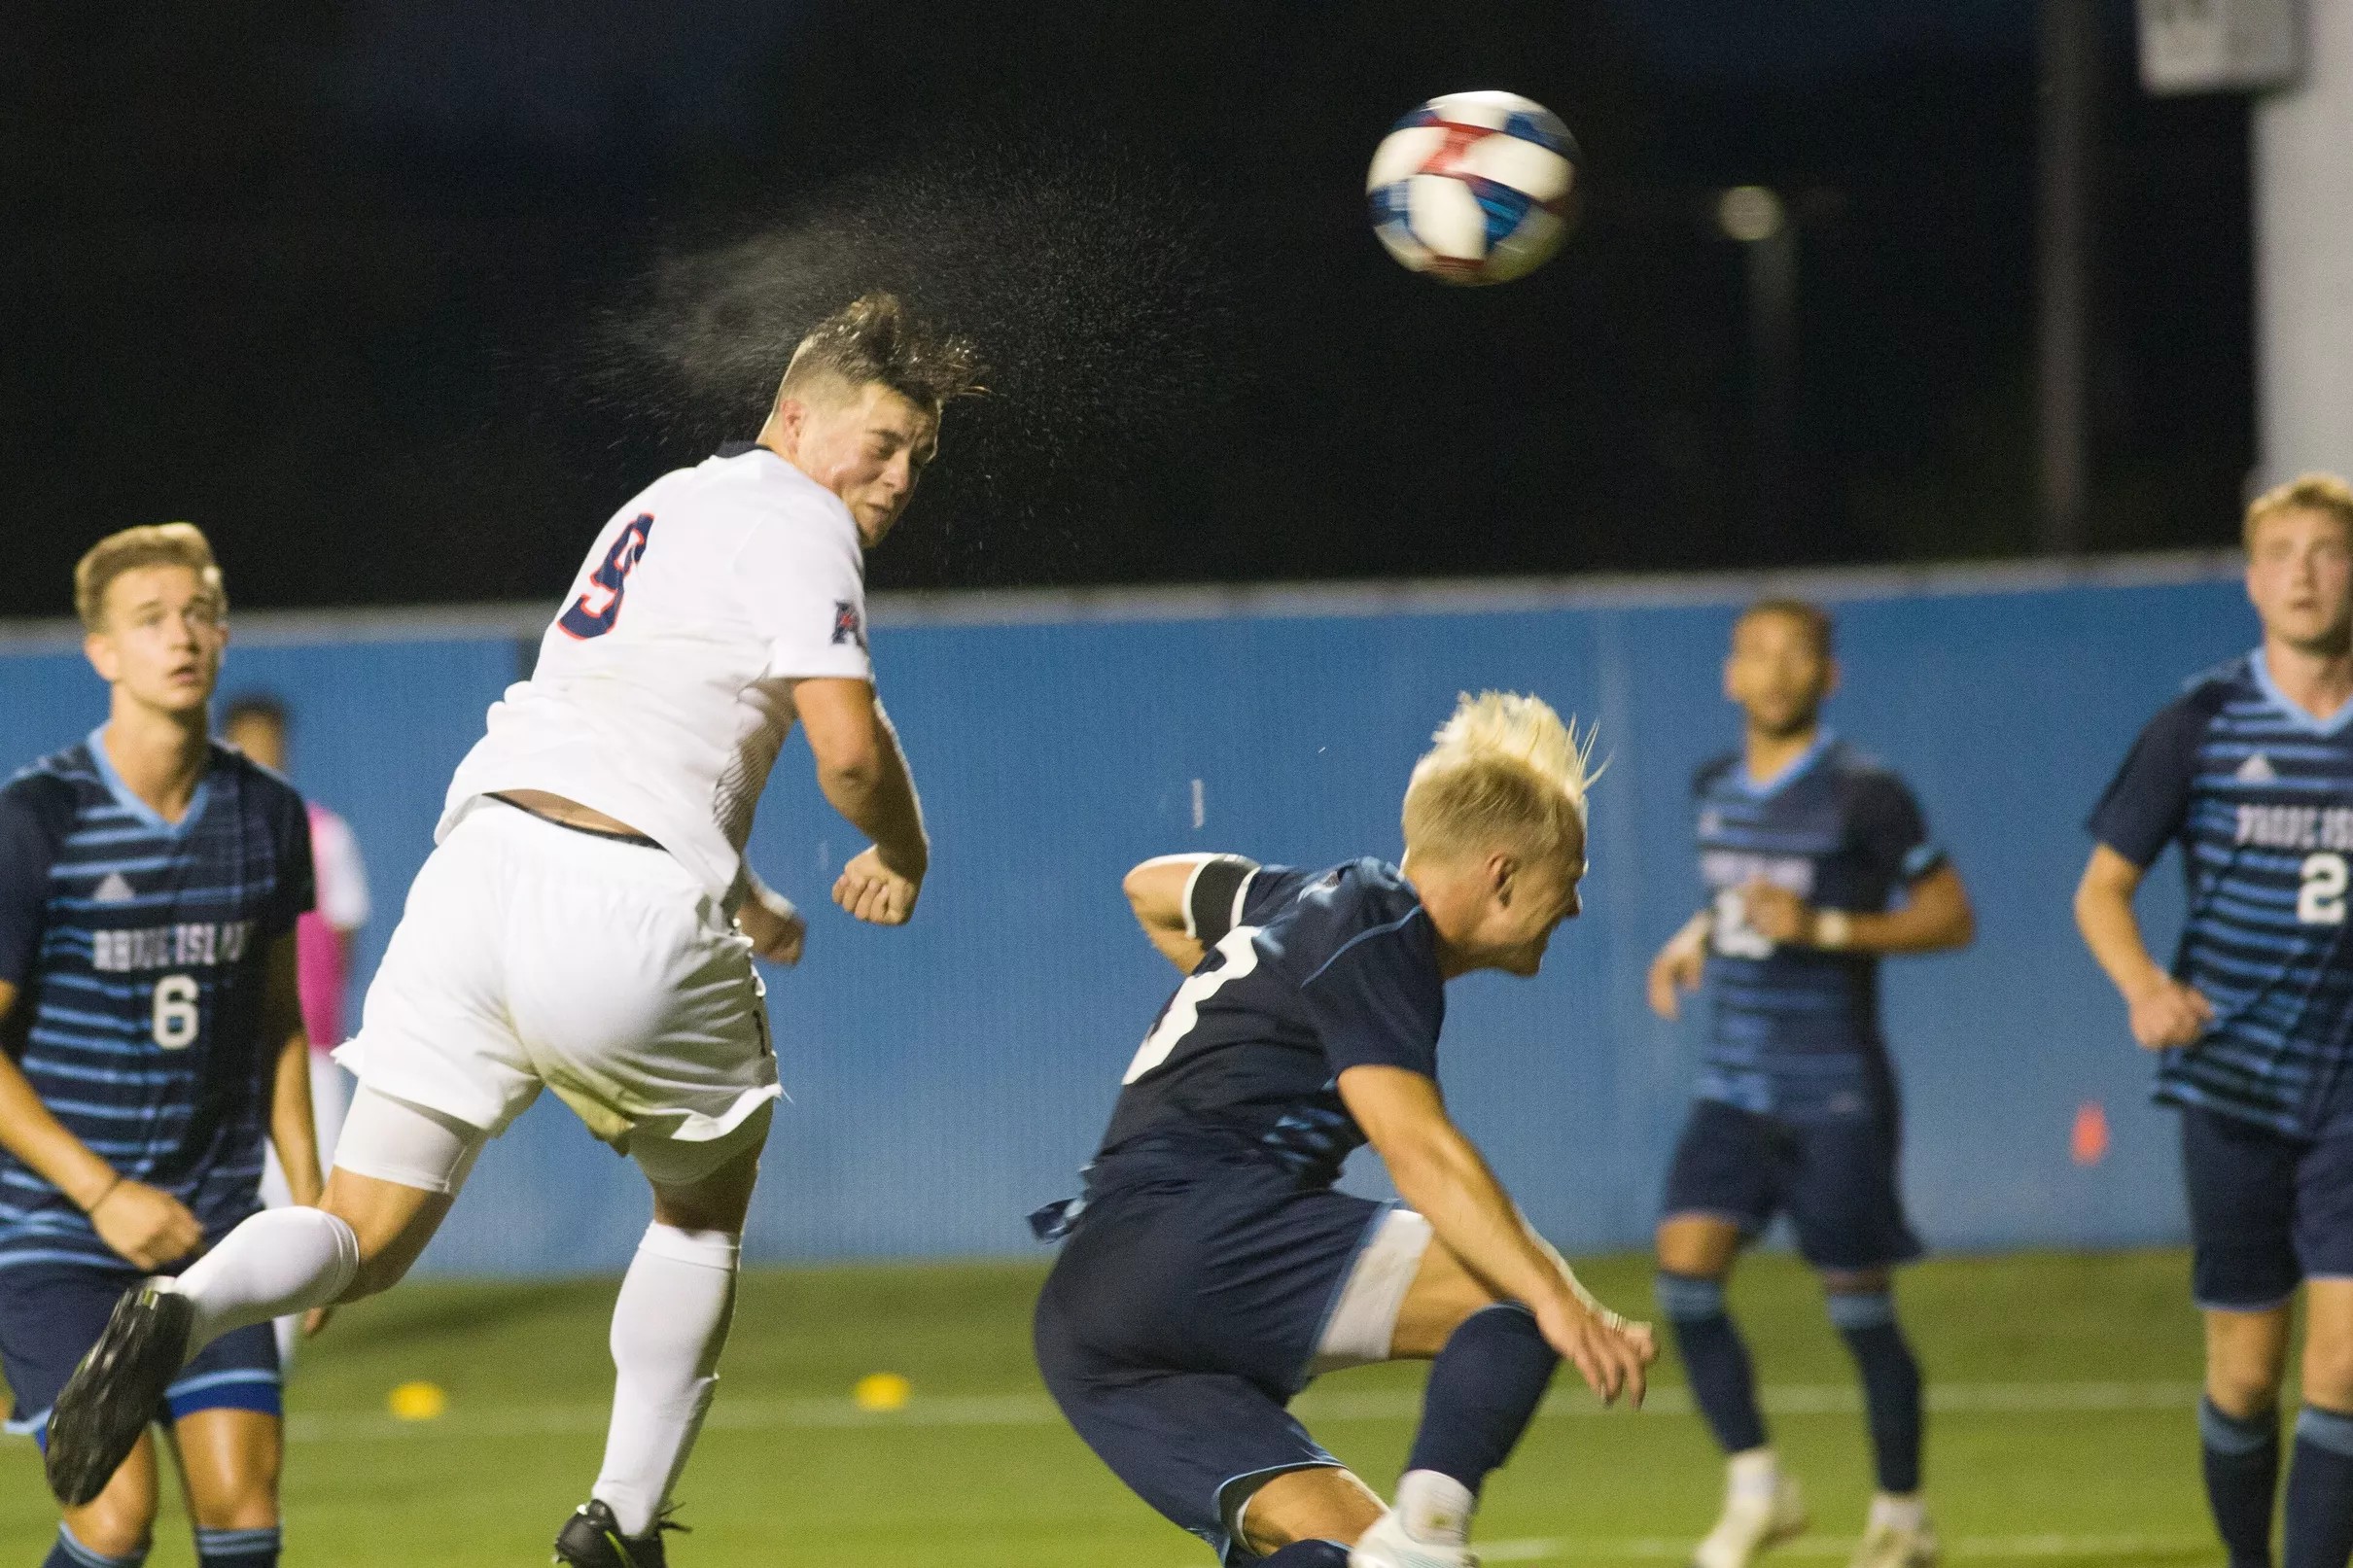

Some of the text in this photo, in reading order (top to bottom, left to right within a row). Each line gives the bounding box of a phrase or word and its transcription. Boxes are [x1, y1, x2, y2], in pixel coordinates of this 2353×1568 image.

[557, 512, 654, 641] 9
[2297, 852, 2348, 923] 2
[152, 975, 199, 1050] 6
